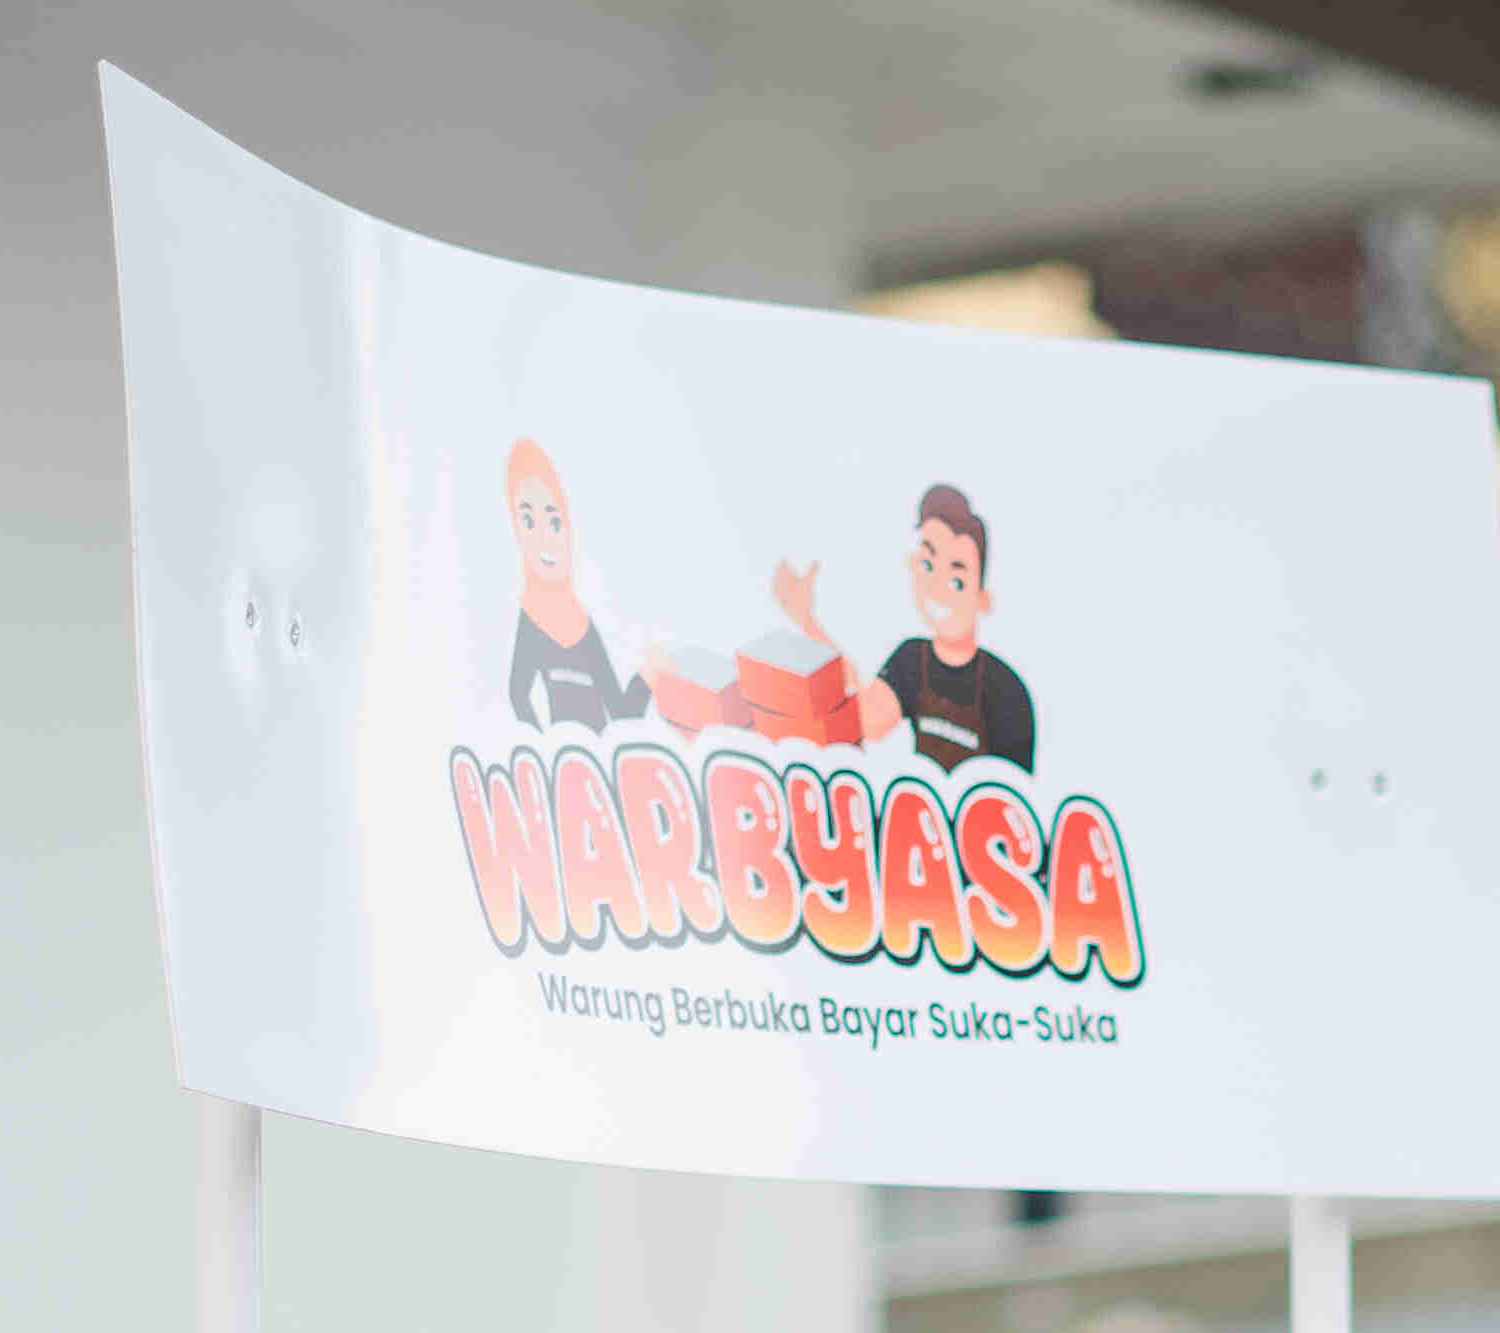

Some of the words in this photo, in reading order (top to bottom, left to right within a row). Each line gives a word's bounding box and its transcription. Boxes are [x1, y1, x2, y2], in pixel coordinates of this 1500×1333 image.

[451, 745, 1146, 990] WARBYASA
[538, 971, 666, 1038] Warung
[670, 987, 812, 1034] Berbuka
[819, 998, 917, 1050] Bayar
[929, 1002, 1118, 1043] Suka-Suka
